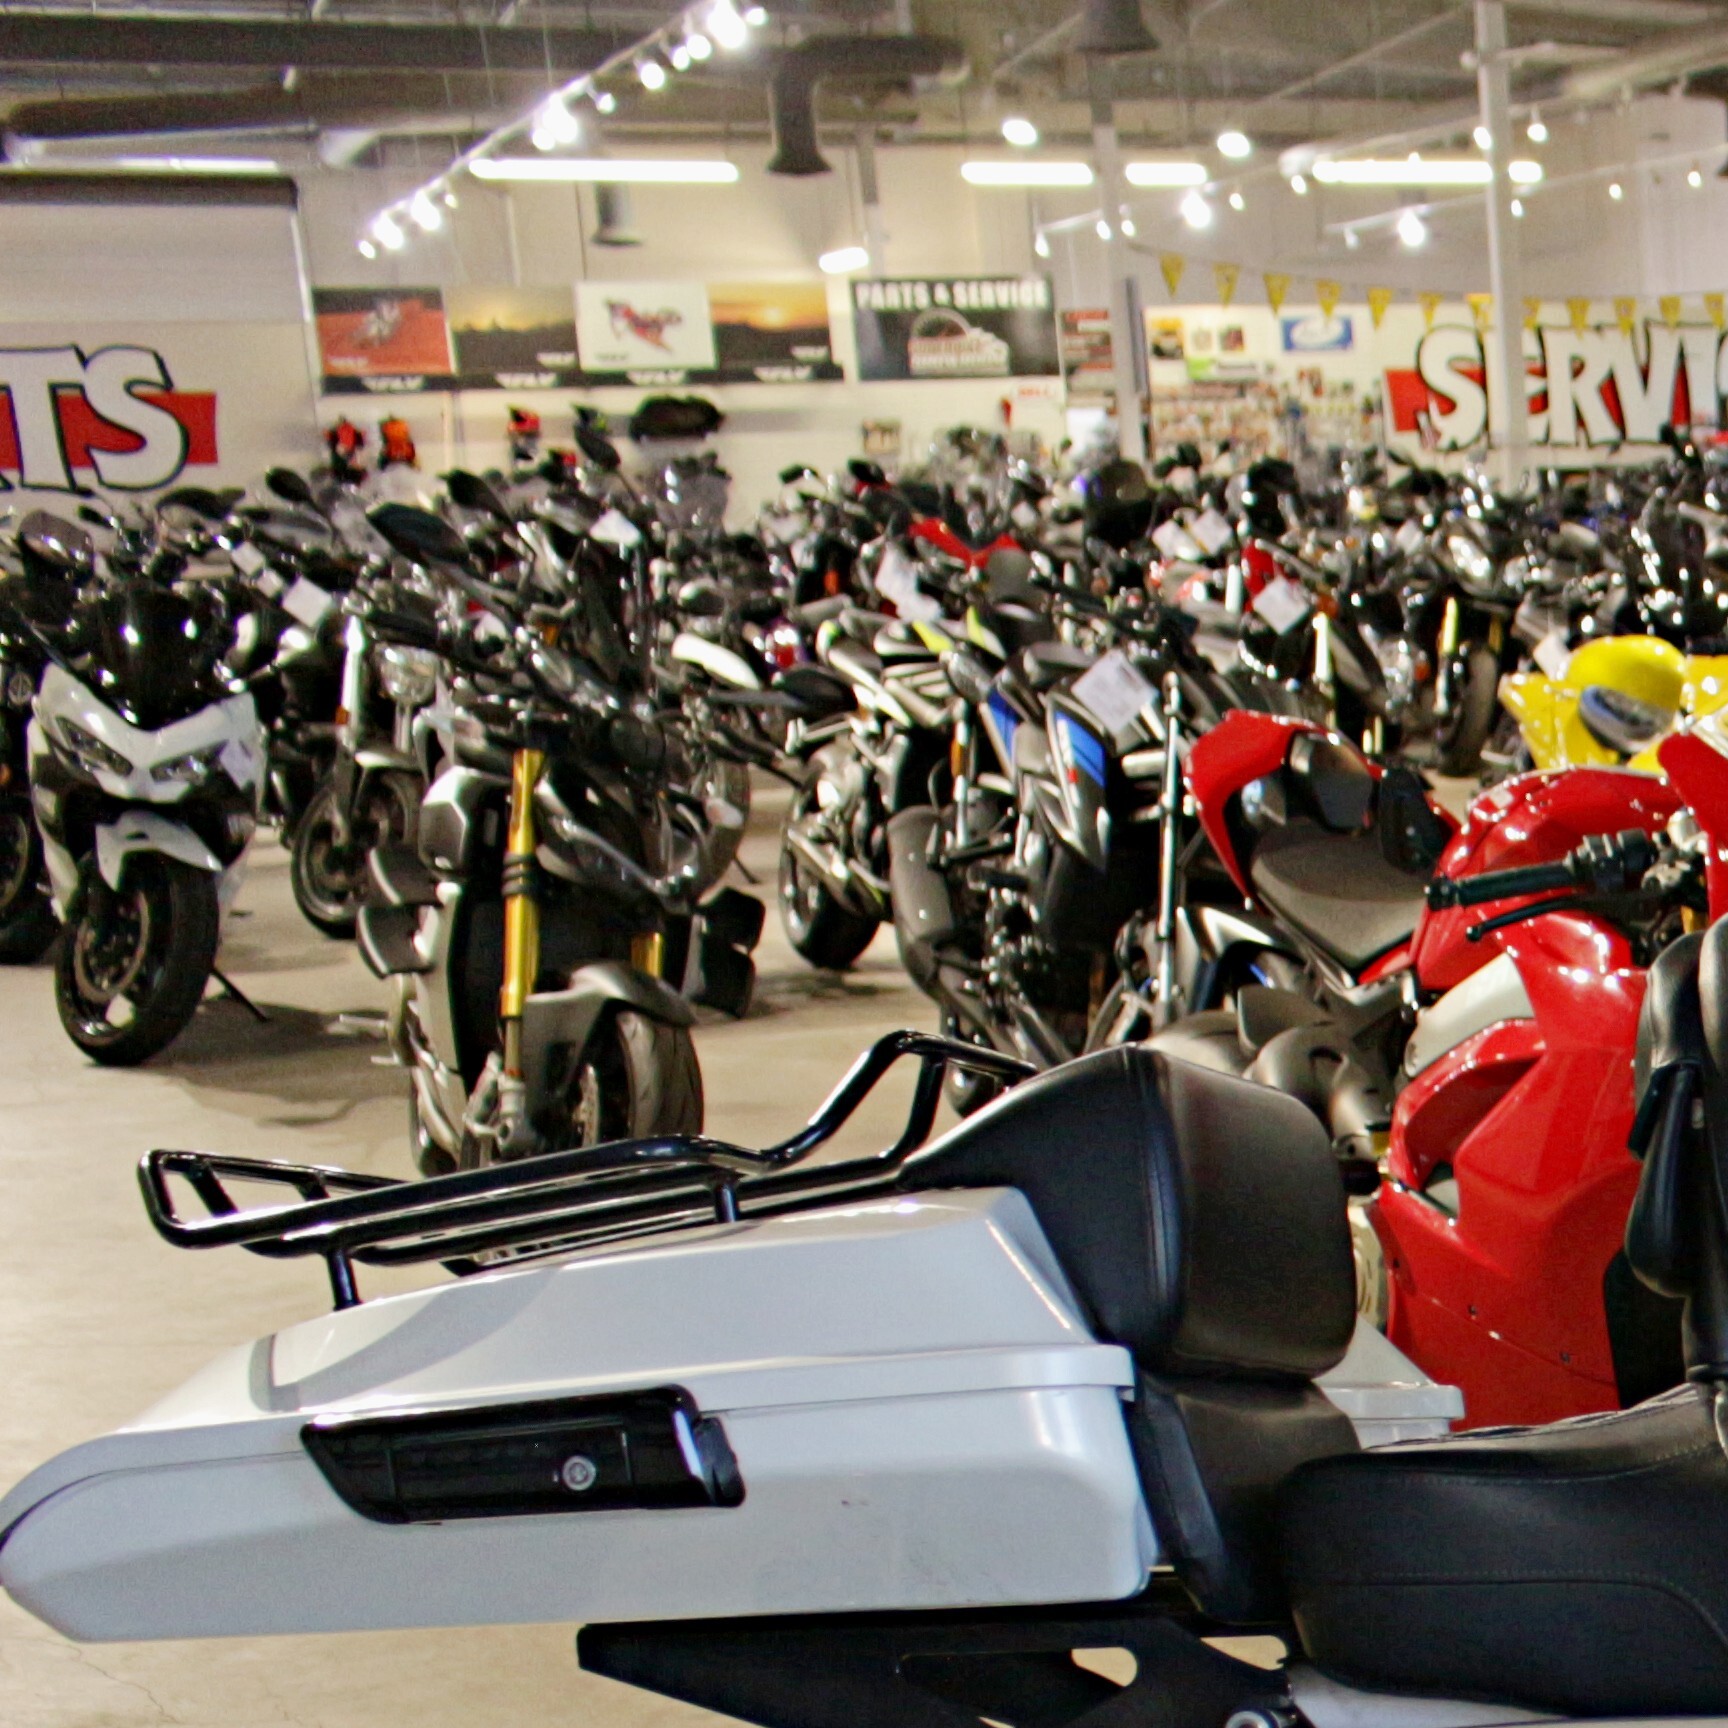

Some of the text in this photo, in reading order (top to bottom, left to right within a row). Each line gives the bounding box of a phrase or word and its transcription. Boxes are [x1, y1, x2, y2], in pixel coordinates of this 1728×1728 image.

[855, 281, 930, 310] PARTS
[953, 279, 1047, 310] SERVICE
[0, 344, 190, 493] TS
